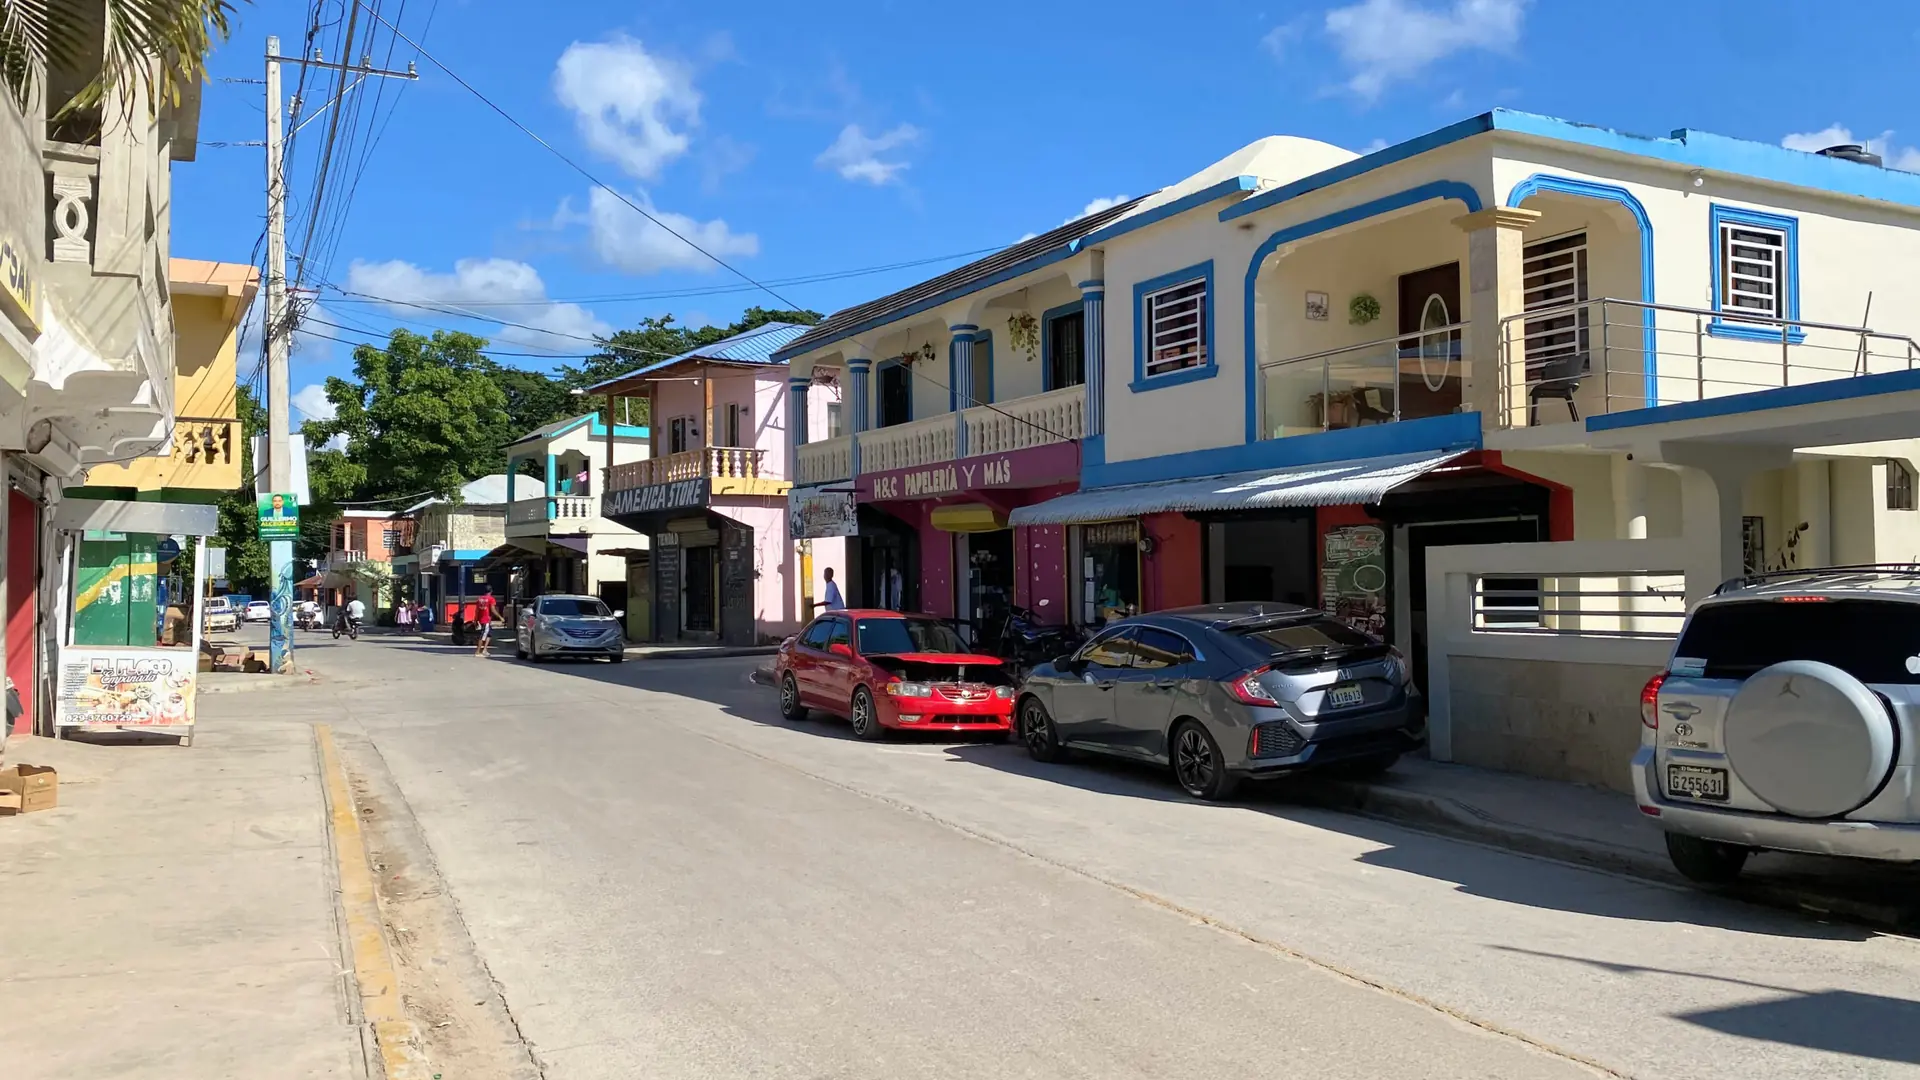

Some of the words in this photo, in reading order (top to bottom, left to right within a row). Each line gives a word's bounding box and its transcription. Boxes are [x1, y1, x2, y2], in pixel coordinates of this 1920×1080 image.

[873, 476, 898, 499] H&C
[903, 464, 958, 497] PAPELERÍA
[962, 464, 977, 488] Y
[984, 456, 1011, 486] MÁS
[613, 484, 666, 515] AMERICA
[667, 479, 703, 508] STORE
[1672, 775, 1722, 793] G255631
